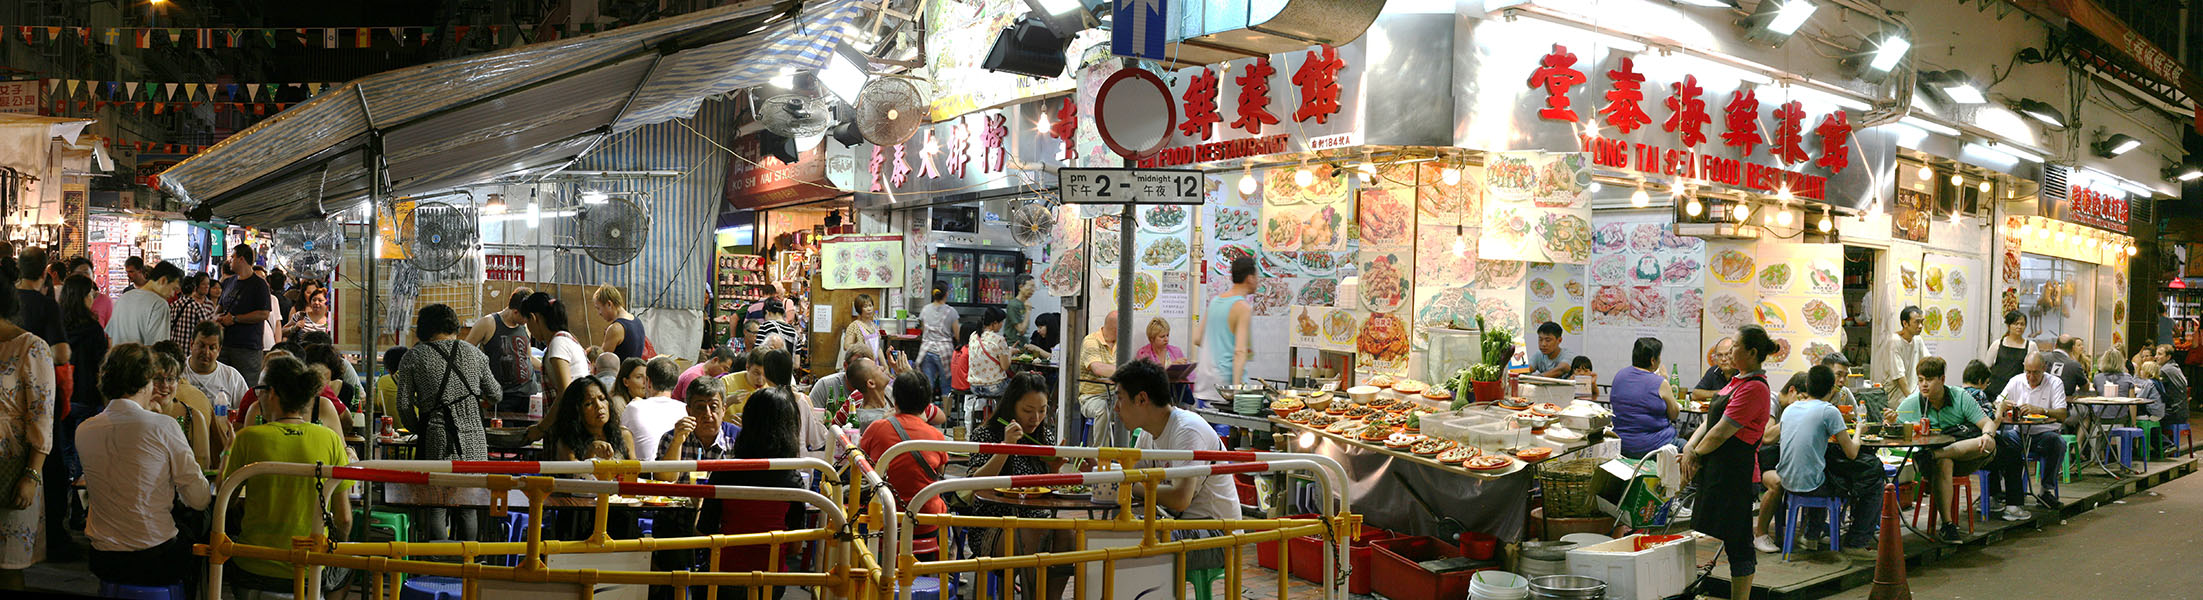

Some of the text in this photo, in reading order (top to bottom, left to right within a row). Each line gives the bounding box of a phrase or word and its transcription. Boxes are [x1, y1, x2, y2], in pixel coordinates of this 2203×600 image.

[1527, 43, 1852, 175] 堂泰海鮮菜館
[1158, 144, 1194, 167] FOOD
[1634, 143, 1660, 173] TAI
[1663, 148, 1697, 178] SEA
[1702, 153, 1741, 185] FOOD
[774, 165, 800, 182] SHOES
[1067, 184, 1166, 197] 下午 午夜
[1070, 174, 1087, 183] pm
[1095, 174, 1111, 197] 2
[1137, 175, 1171, 183] midnight
[1173, 176, 1198, 197] 12
